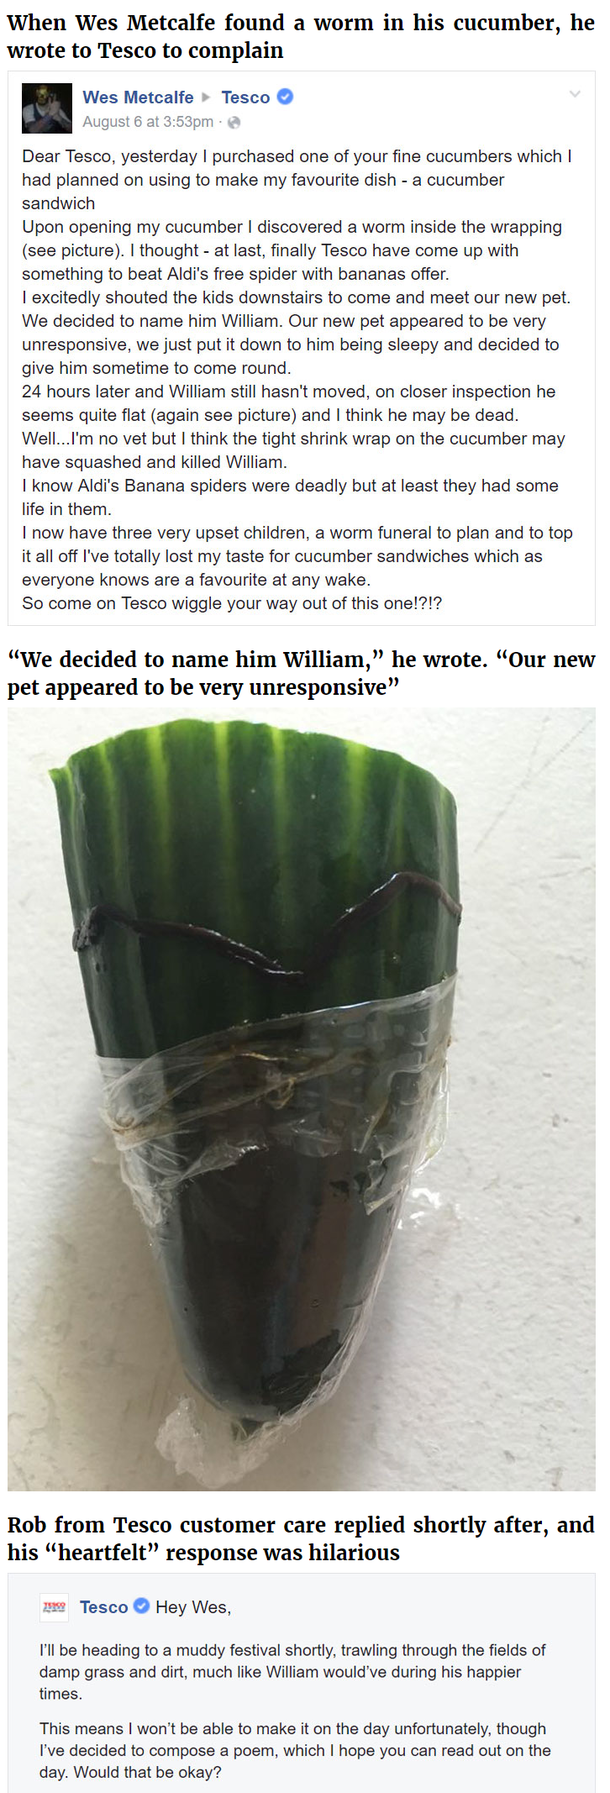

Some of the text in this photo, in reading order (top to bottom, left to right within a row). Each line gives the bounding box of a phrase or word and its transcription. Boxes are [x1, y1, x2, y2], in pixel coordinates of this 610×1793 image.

[82, 91, 270, 104] Wes Metcalfe Tesco
[22, 196, 95, 209] sandwich
[80, 1600, 231, 1617] Tesco Hey Wes,
